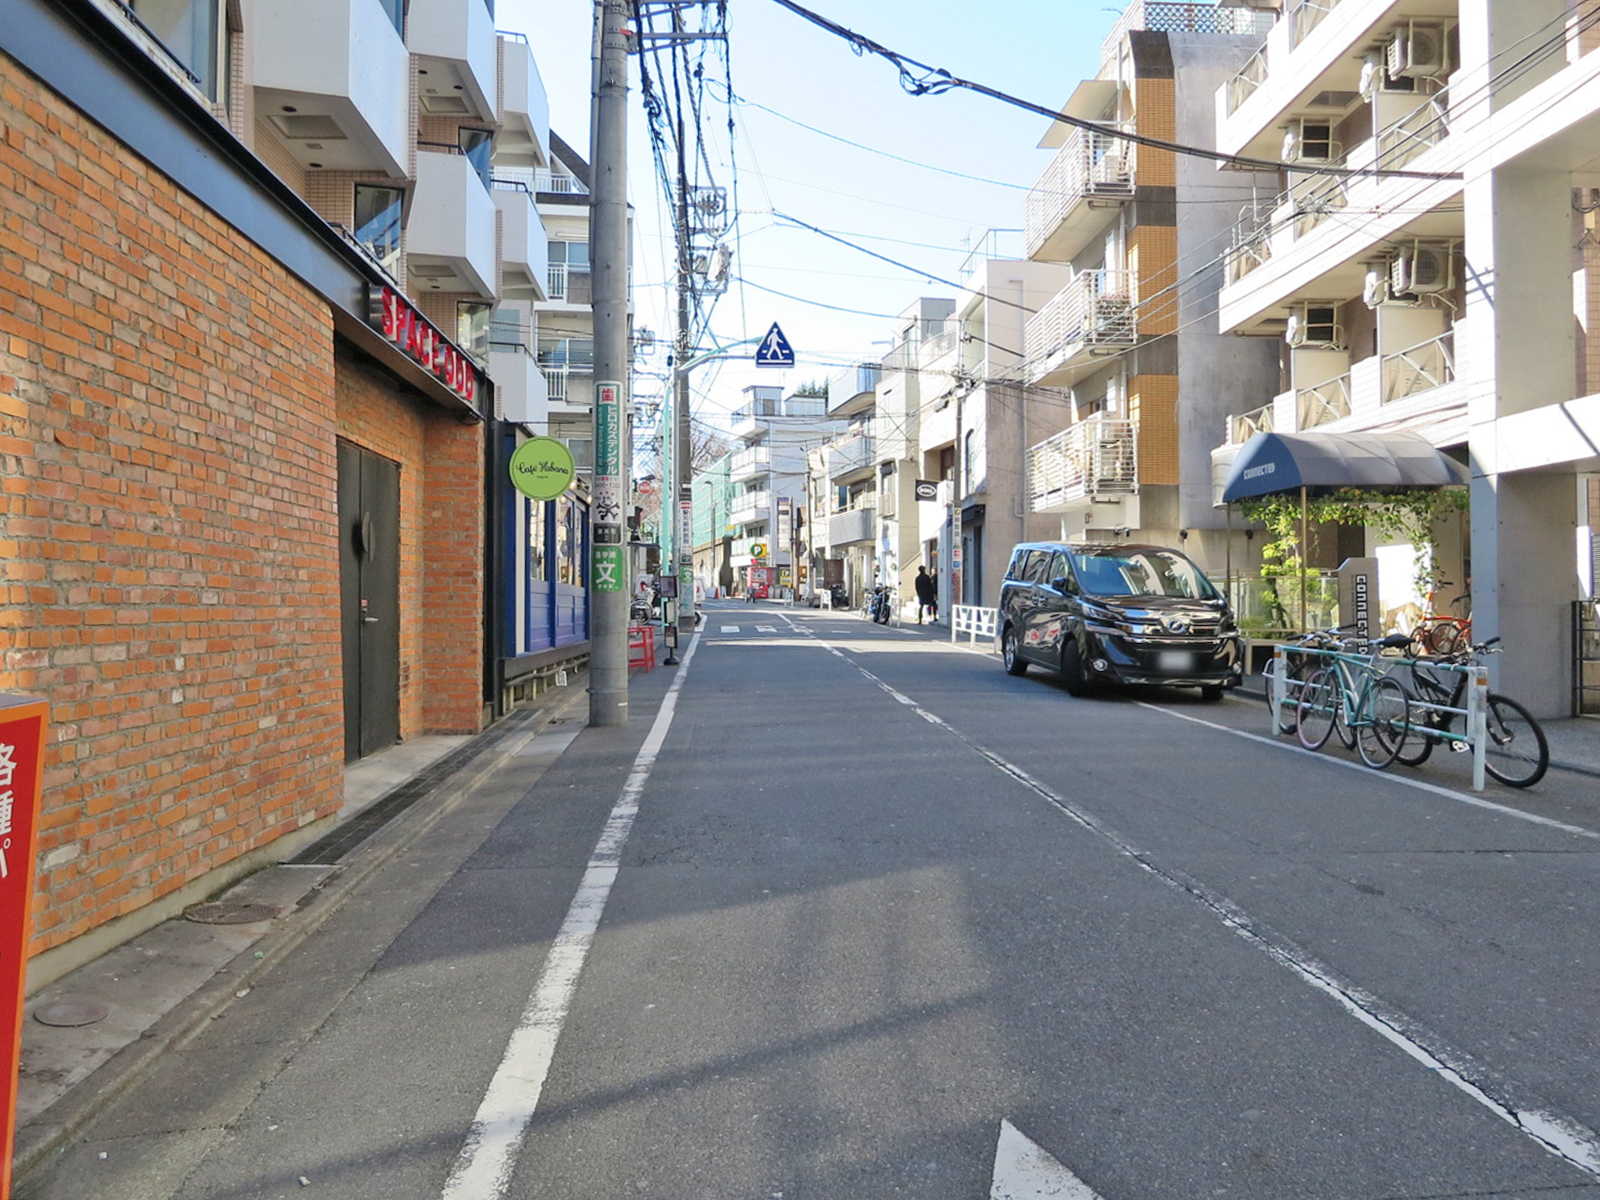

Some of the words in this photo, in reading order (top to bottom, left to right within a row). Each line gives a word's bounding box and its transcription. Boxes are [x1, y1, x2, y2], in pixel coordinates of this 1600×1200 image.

[381, 286, 441, 375] SPACE
[601, 388, 614, 402] 歯
[606, 406, 618, 475] ヒロカズデンタル
[539, 461, 569, 474] Habana
[1243, 462, 1276, 480] CONNECTED
[595, 561, 616, 583] 文
[1356, 574, 1369, 655] CONNECTED
